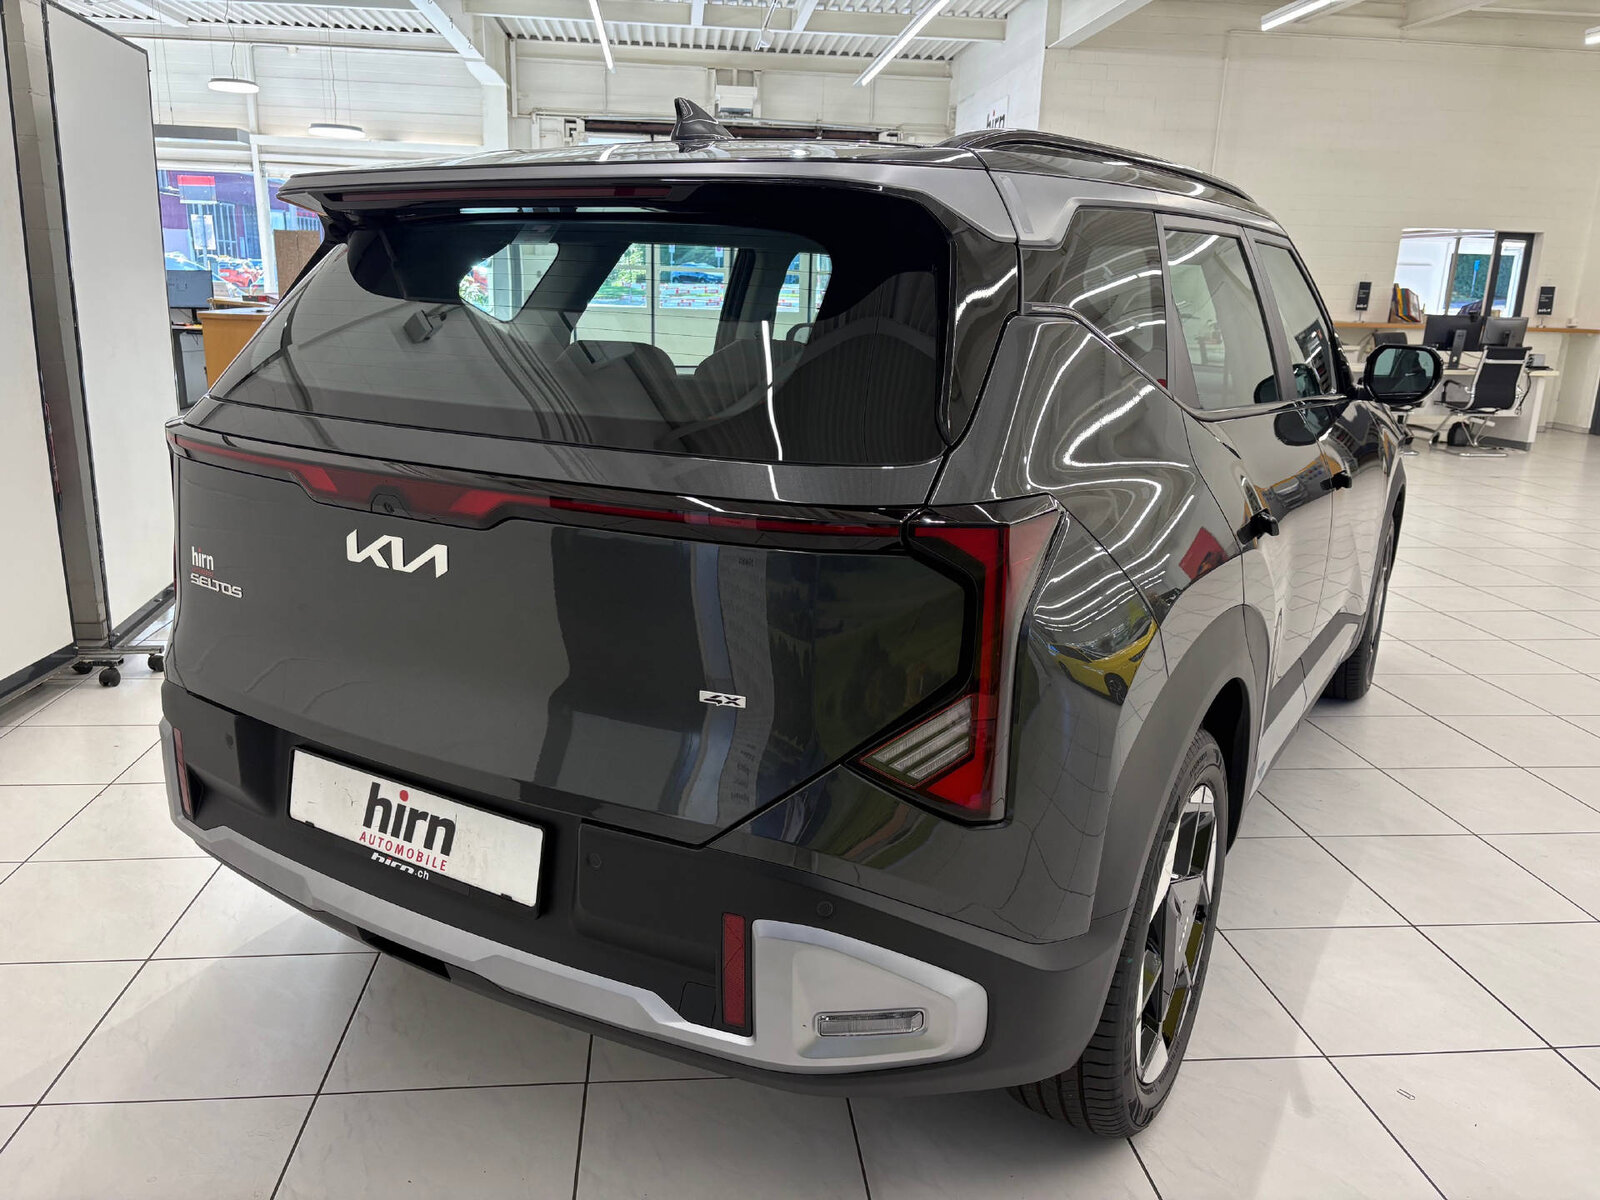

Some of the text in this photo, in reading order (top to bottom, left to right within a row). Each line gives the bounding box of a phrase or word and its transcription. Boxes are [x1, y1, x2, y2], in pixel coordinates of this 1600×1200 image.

[986, 109, 1006, 129] hirn
[191, 546, 215, 571] hirn
[346, 529, 448, 578] KIA
[190, 572, 243, 599] SELTOS
[362, 781, 457, 857] hirn
[358, 831, 448, 872] AUTOMOBILE
[370, 852, 430, 881] hirn.ch
